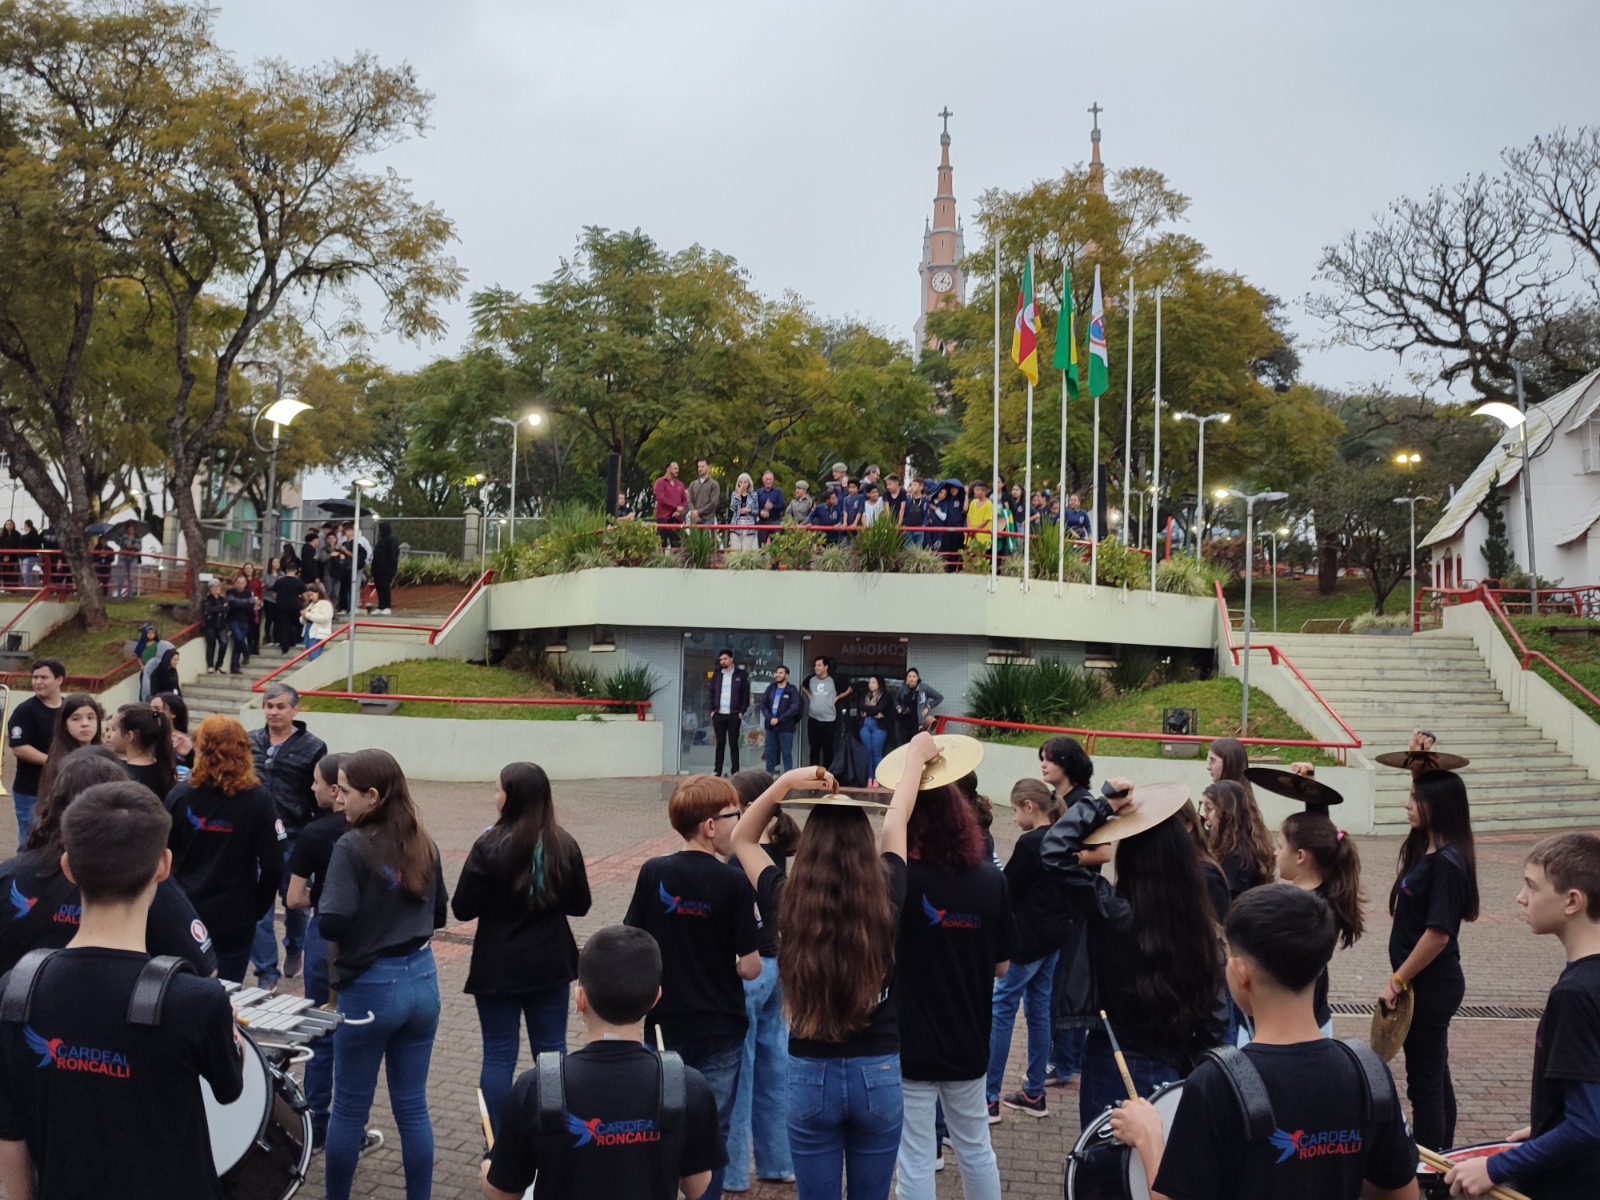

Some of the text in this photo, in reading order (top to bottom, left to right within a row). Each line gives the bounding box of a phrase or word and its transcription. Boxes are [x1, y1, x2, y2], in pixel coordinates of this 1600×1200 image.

[57, 1044, 131, 1067] CARDEAL
[56, 1057, 131, 1078] RONCALLI
[597, 1119, 655, 1135] CARDEA
[597, 1131, 661, 1146] RONCALLI
[1299, 1129, 1364, 1147] CARDEAL
[1299, 1142, 1362, 1160] RONCALLI
